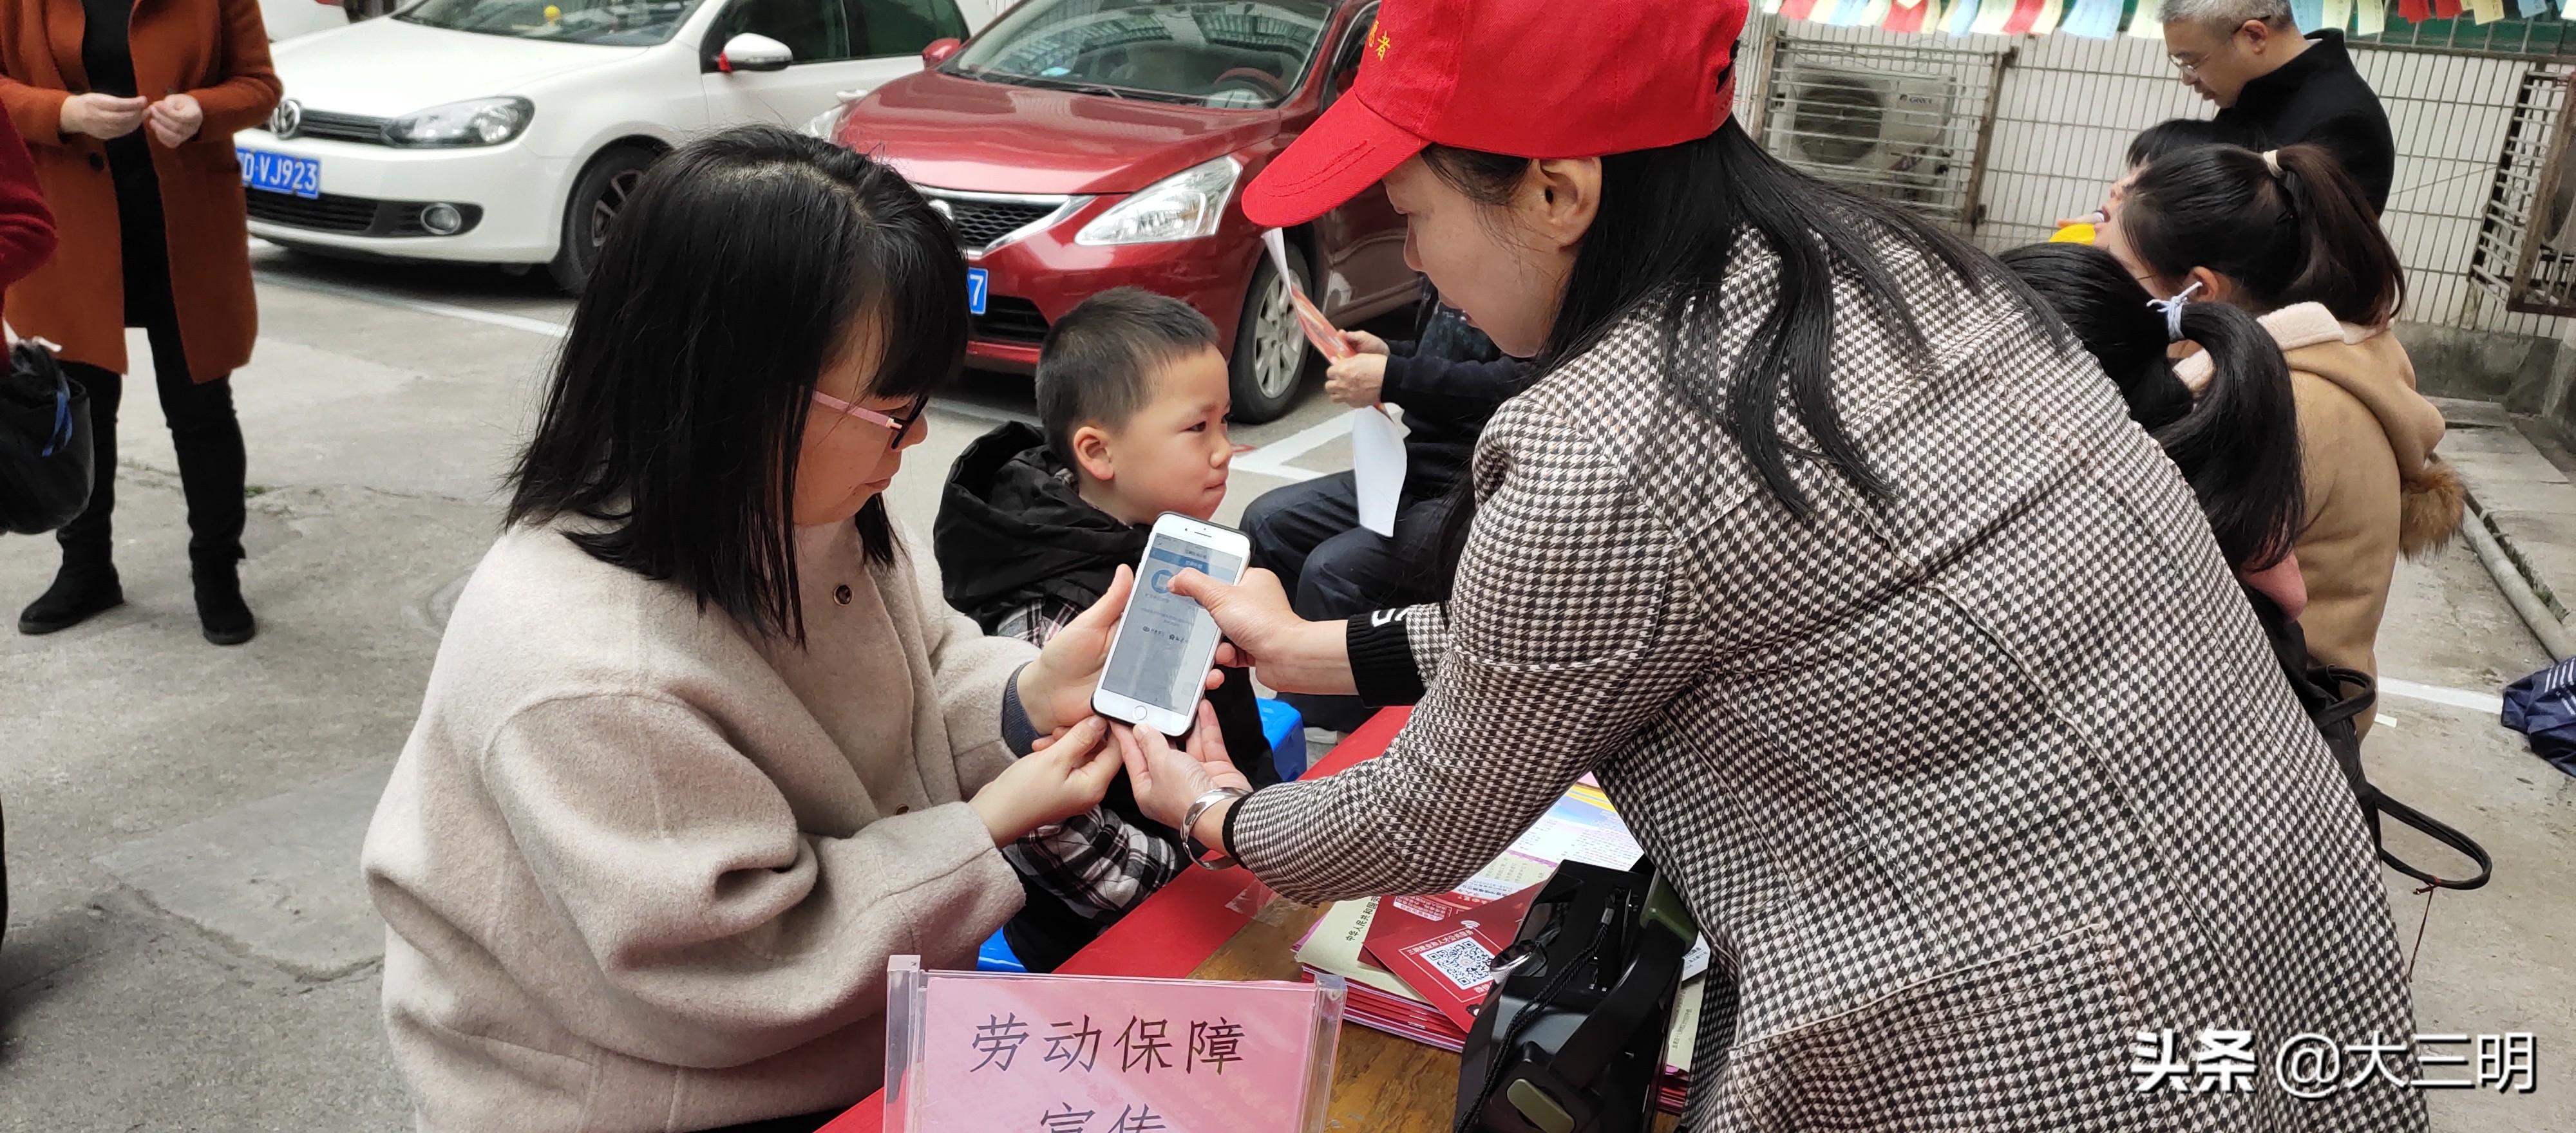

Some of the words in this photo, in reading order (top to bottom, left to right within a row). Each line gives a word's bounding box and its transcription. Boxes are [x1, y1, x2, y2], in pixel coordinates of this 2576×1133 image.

[969, 274, 984, 306] 7
[969, 1011, 1246, 1075] 劳动保障
